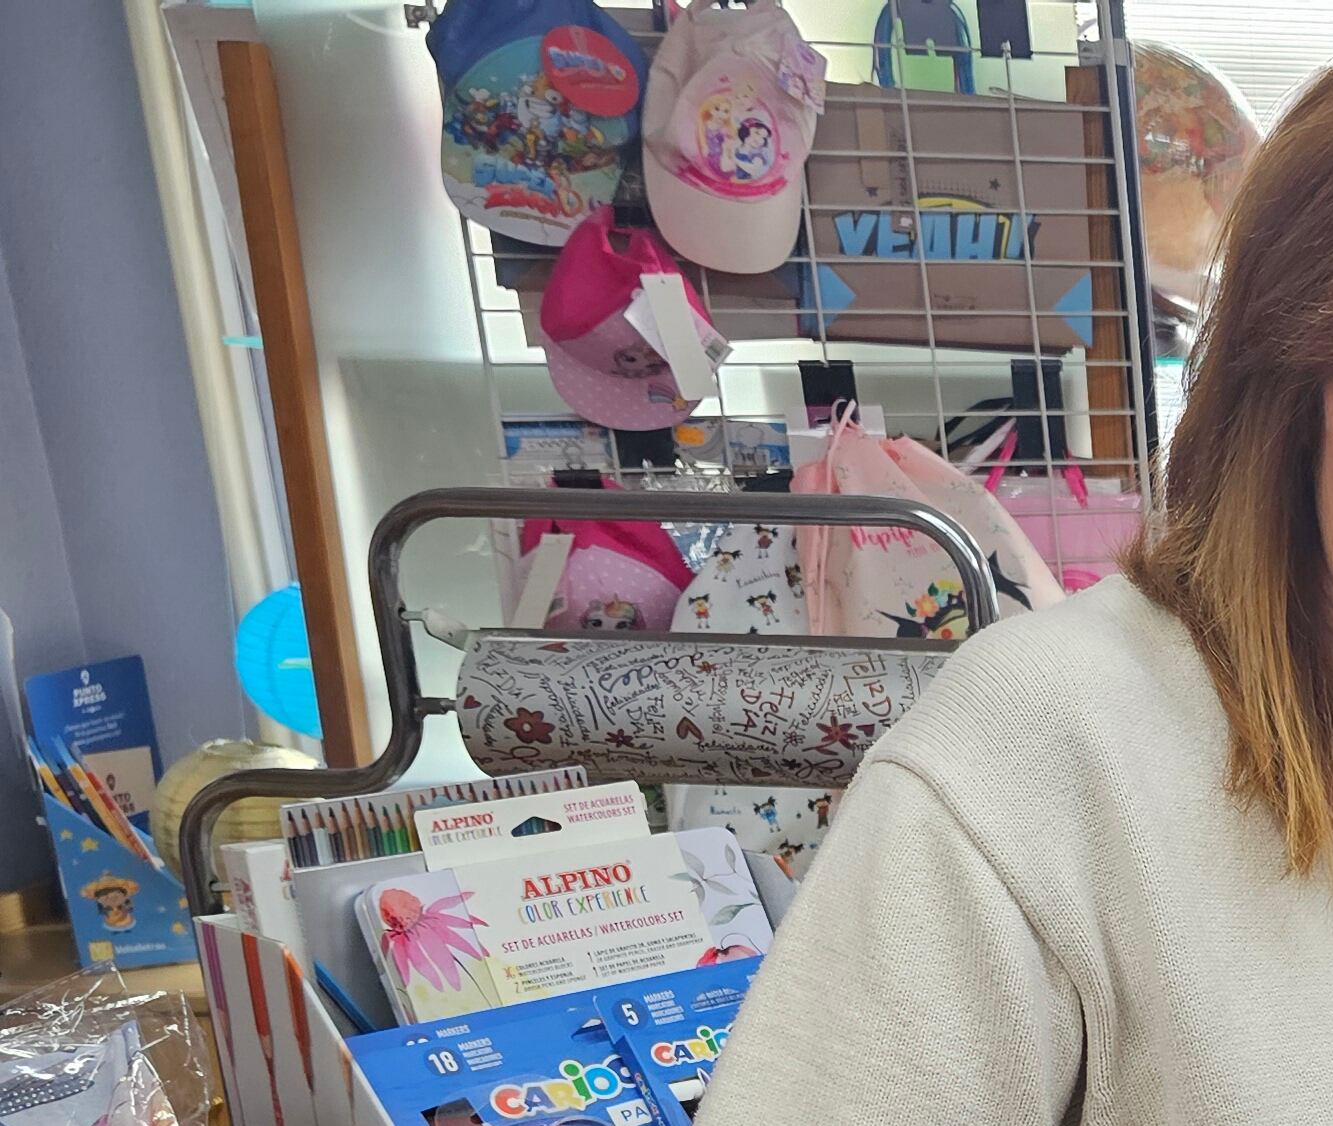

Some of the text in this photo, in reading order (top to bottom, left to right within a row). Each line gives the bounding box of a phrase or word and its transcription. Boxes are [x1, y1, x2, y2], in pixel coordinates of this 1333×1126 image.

[72, 683, 103, 698] PUNTO
[563, 795, 634, 813] SET DE ACUARELAS
[566, 805, 636, 824] WATERCOLORS SET
[431, 813, 493, 833] ALPINO
[521, 863, 633, 901] ALPINO
[517, 885, 652, 926] COLOR EXPERIENCE
[501, 941, 519, 954] SET
[522, 937, 535, 951] DE
[537, 927, 593, 946] ACUARELAS
[599, 911, 670, 935] WATERCOLORS
[669, 910, 686, 922] SET
[622, 1003, 638, 1026] 5
[428, 1050, 459, 1075] 18
